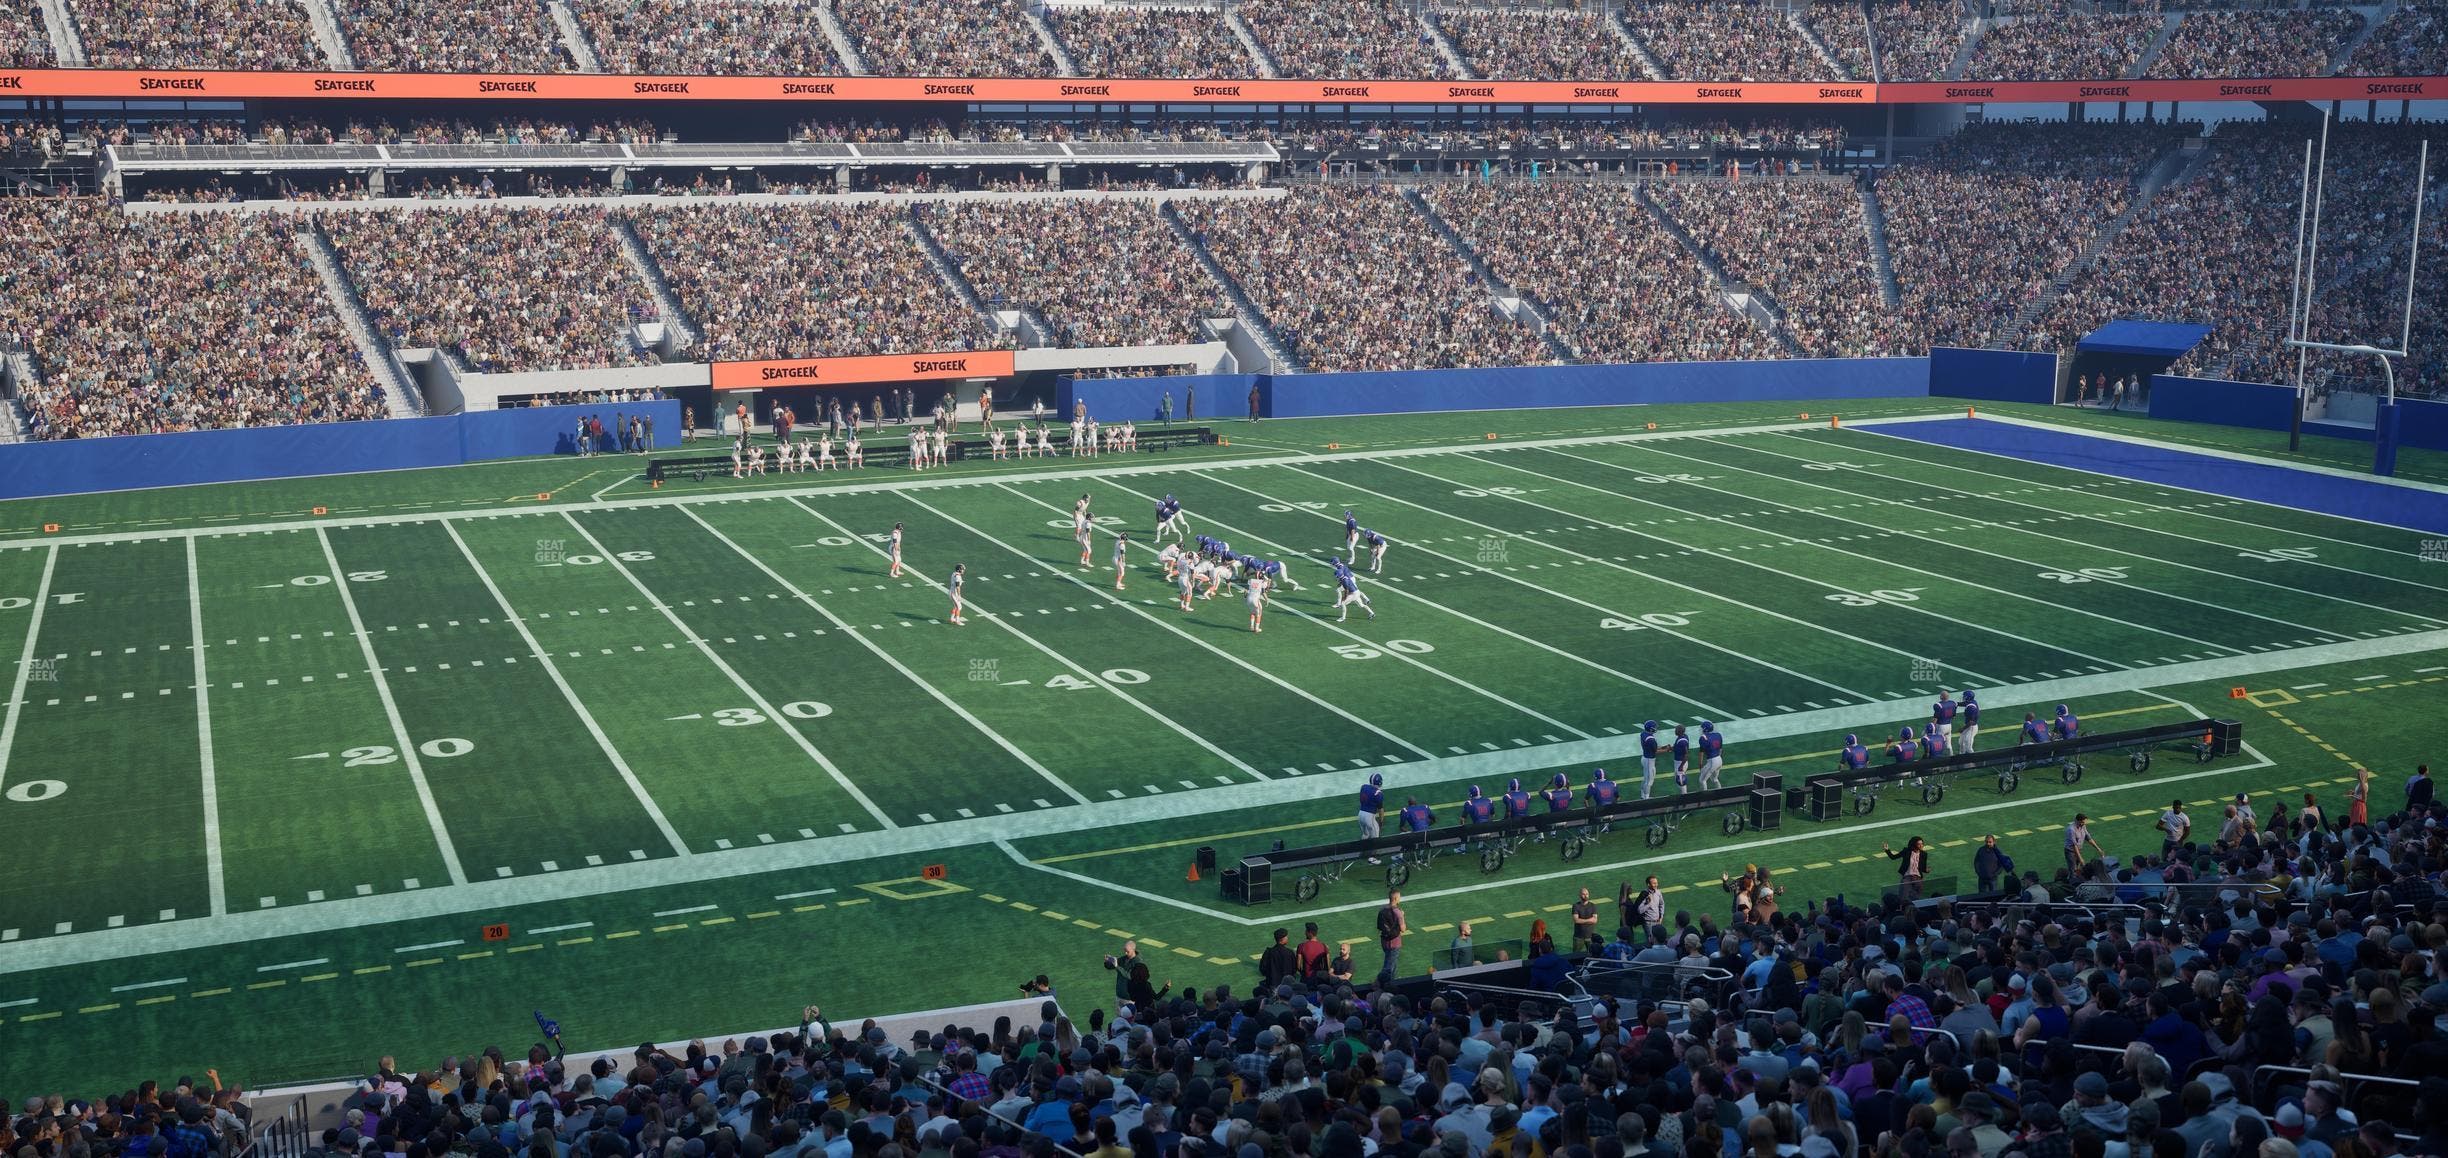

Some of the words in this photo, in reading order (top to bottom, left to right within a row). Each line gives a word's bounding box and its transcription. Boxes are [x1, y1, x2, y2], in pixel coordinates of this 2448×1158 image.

[140, 78, 205, 90] SEATGEEK
[315, 80, 375, 91] SEATGEEK
[480, 81, 536, 92] SEATGEEK
[635, 83, 688, 93] SEATGEEK
[783, 84, 834, 94] SEATGEEK
[925, 84, 974, 95] SEATGEEK
[1061, 85, 1109, 96] SEATGEEK
[1194, 86, 1240, 96] SEATGEEK
[1323, 87, 1368, 97] SEATGEEK
[1449, 87, 1494, 97] SEATGEEK
[1574, 88, 1618, 98] SEATGEEK
[1697, 88, 1741, 98] SEATGEEK
[1819, 88, 1863, 98] SEATGEEK
[1946, 87, 1994, 97] SEATGEEK
[2080, 86, 2130, 96] SEATGEEK
[2221, 85, 2272, 95] SEATGEEK
[2367, 83, 2423, 94] SEATGEEK
[762, 365, 818, 380] SEATGEEK
[914, 359, 967, 373] SEATGEEK
[2037, 567, 2124, 583] 20
[1824, 588, 1918, 607] 30
[1600, 613, 1689, 631] 40
[1328, 640, 1435, 661] 50
[1044, 668, 1150, 690] 40
[712, 701, 832, 726] 30
[340, 738, 474, 767] 20
[929, 867, 940, 877] 30
[490, 927, 502, 937] 20
